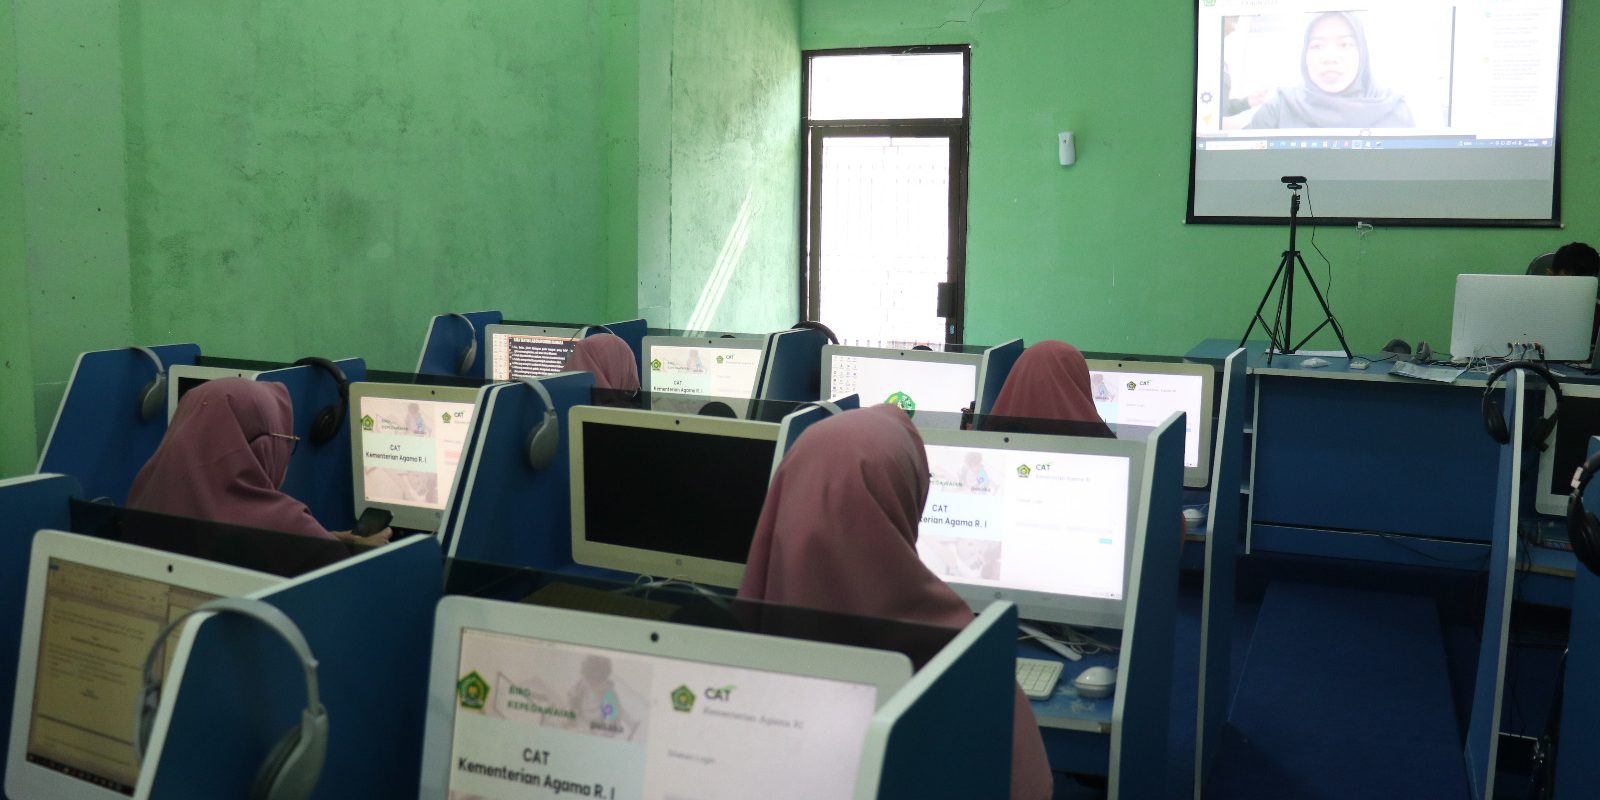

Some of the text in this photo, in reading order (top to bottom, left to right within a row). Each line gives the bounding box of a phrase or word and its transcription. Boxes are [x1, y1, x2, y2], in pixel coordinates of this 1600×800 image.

[390, 444, 400, 452] CAT
[365, 451, 399, 461] Kementerian
[400, 455, 418, 463] Agama
[932, 504, 948, 512] CAT
[945, 517, 973, 528] Agama
[704, 687, 731, 702] CAT
[522, 747, 550, 766] CAT
[458, 757, 541, 787] Kementerian
[544, 773, 590, 797] Agama
